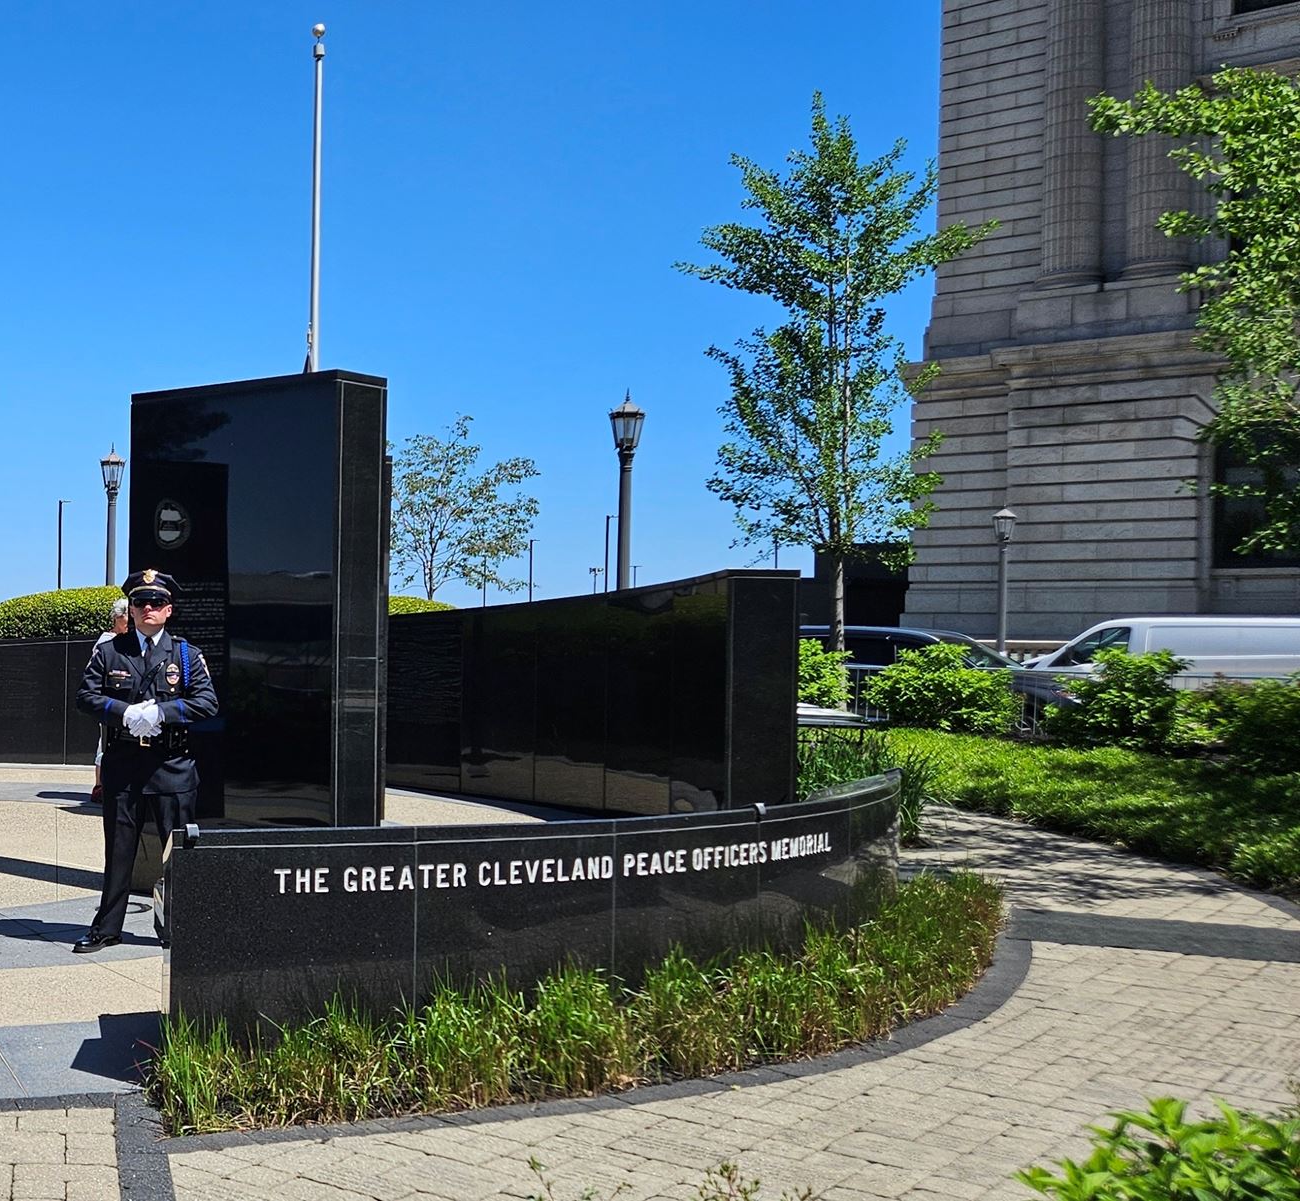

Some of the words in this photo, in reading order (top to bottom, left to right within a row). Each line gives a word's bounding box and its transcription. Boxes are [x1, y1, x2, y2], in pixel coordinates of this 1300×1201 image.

[274, 867, 330, 894] THE
[343, 863, 467, 892] GREATER
[478, 857, 614, 885] CLEVELAND
[623, 849, 687, 877] PEACE
[692, 841, 768, 870] OFFICERS
[770, 832, 832, 862] MEMORIAL
